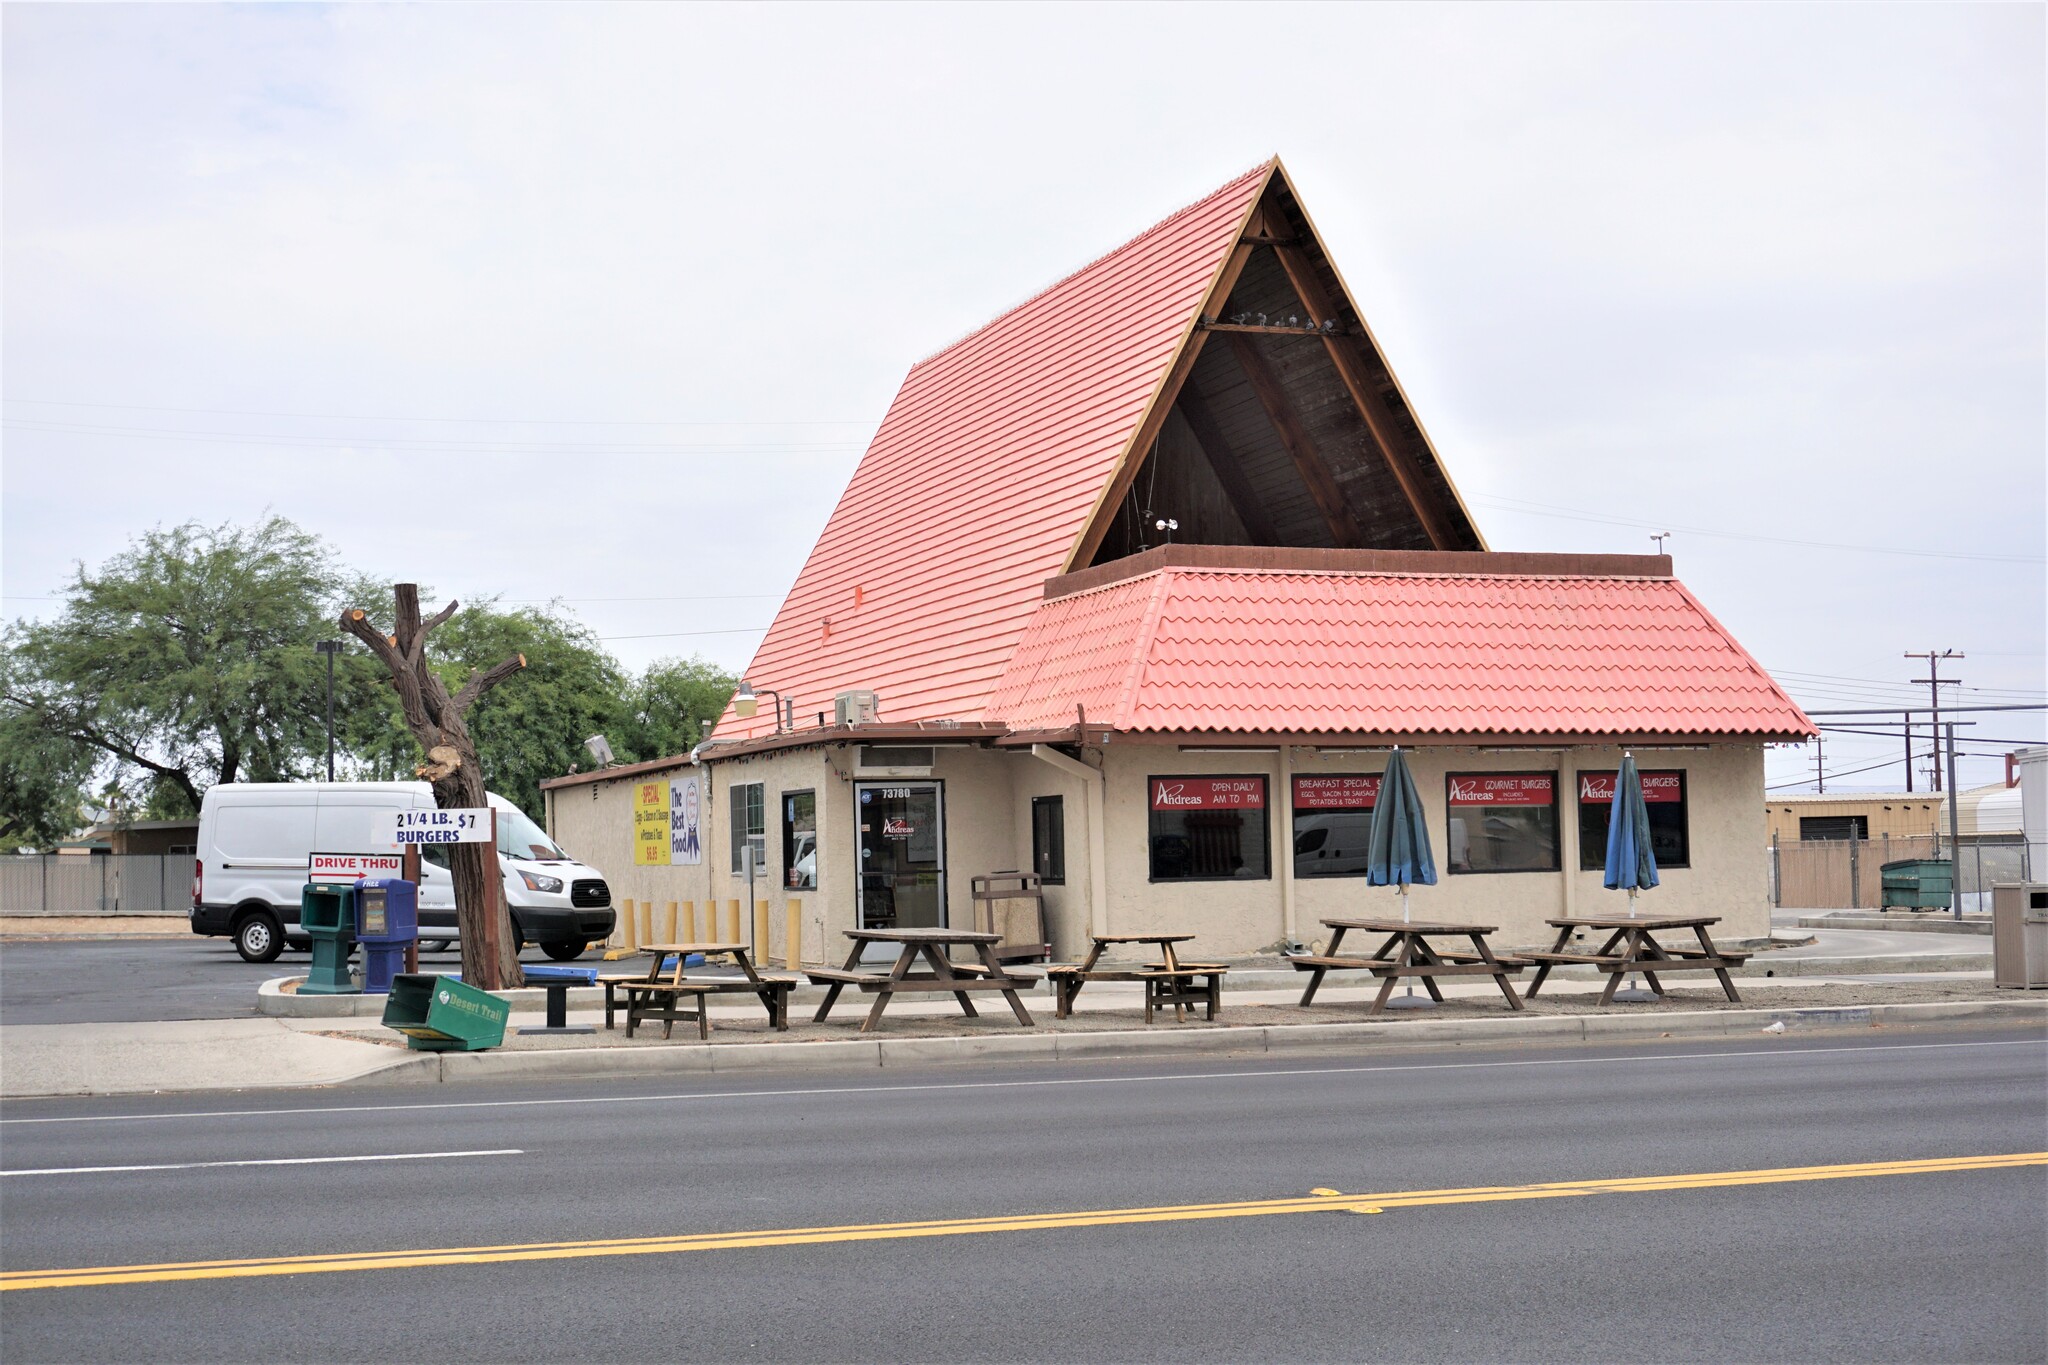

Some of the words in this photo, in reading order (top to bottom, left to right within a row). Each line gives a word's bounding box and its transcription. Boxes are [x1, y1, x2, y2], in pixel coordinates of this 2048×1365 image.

[1211, 783, 1231, 792] OPEN
[1233, 782, 1255, 791] DAILY
[1299, 780, 1340, 788] BREAKFAST
[1343, 780, 1371, 788] SPECIAL
[1485, 780, 1518, 790] GOURMET
[1521, 779, 1551, 789] BURGERS
[1580, 777, 1615, 799] Andre
[1643, 777, 1680, 788] BURGERS
[642, 784, 660, 804] SPECIAL
[671, 787, 682, 808] The
[882, 788, 911, 799] 73780
[1155, 782, 1202, 806] Andreas
[1449, 779, 1494, 802] Andreas
[1212, 794, 1227, 804] AM
[1229, 794, 1240, 804] TO
[1247, 794, 1260, 803] PM
[397, 814, 404, 828] 2
[407, 813, 427, 826] 1/4
[432, 813, 453, 825] LB.
[671, 810, 684, 831] Best
[882, 818, 915, 834] Andreas
[396, 830, 460, 843] BURGERS
[672, 832, 687, 853] Food
[315, 858, 356, 868] DRIVE
[361, 858, 399, 869] THRU
[449, 993, 480, 1014] Desert
[481, 1004, 502, 1021] Trail
